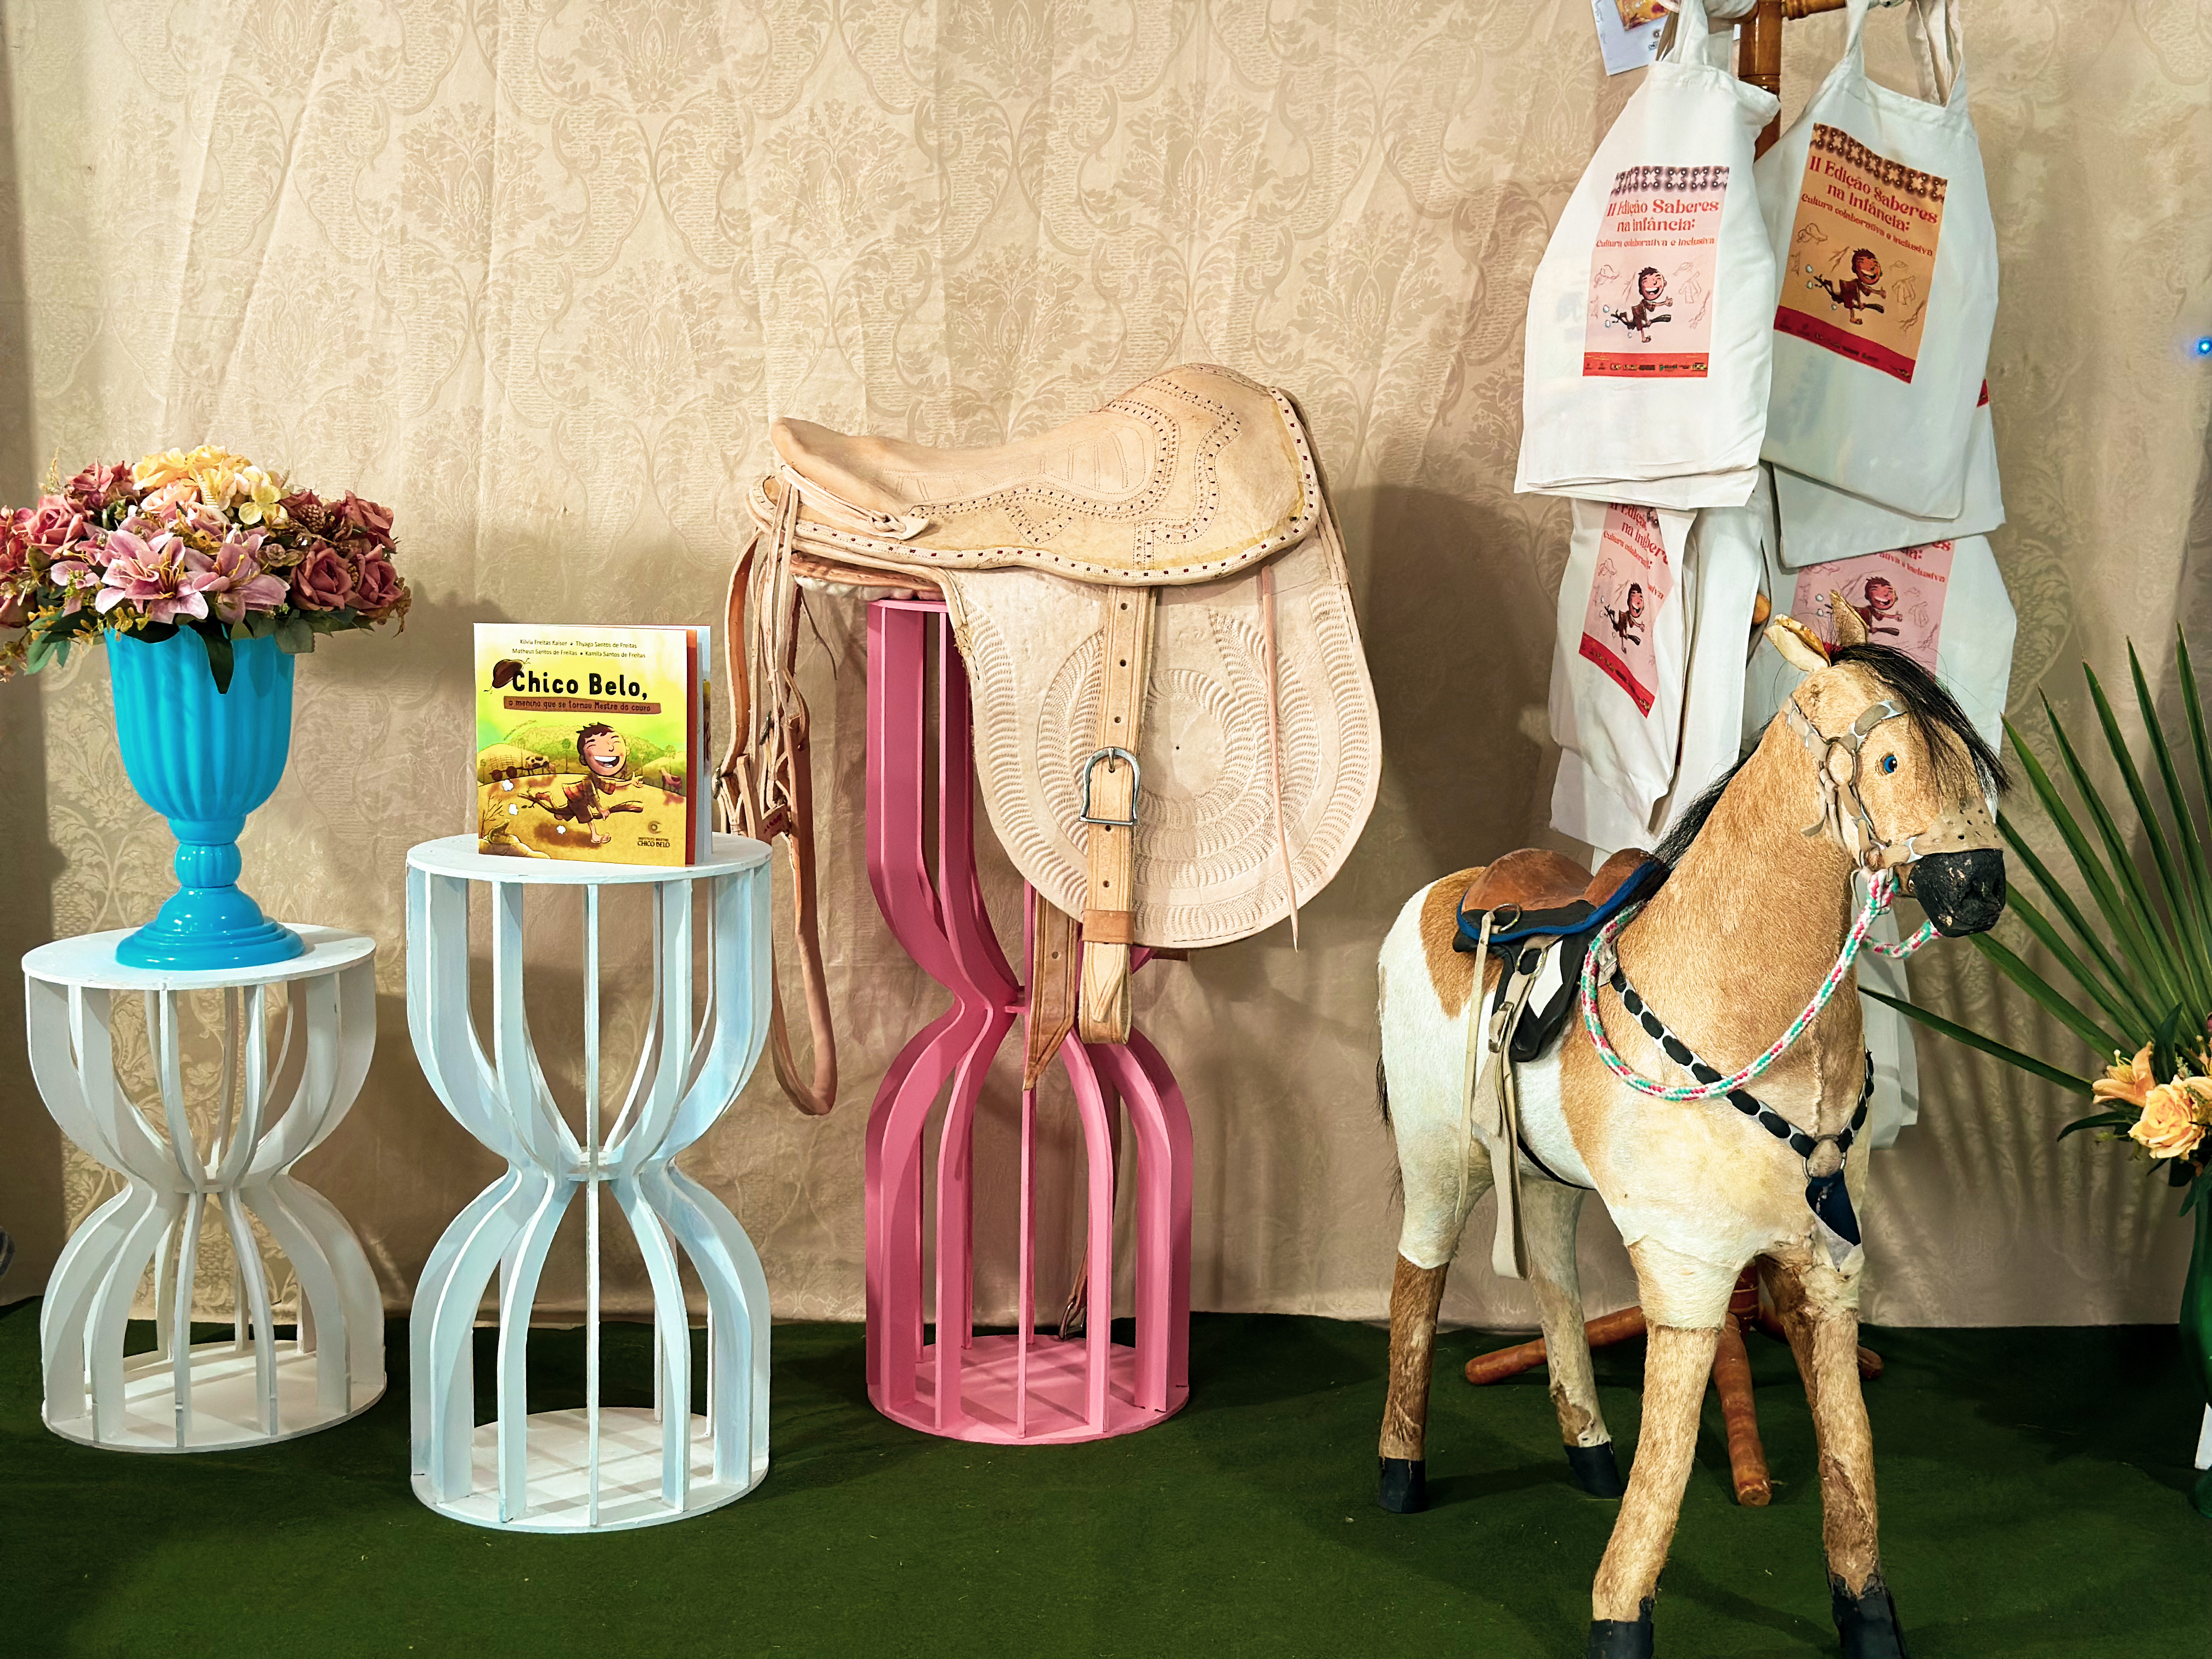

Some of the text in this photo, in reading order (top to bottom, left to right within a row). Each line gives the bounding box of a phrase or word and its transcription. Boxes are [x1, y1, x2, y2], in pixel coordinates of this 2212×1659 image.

[1810, 156, 1938, 224] II Edição Saberes
[1827, 184, 1844, 201] na
[1607, 199, 1719, 217] II Edição Saberes
[1802, 193, 1833, 212] Cultura
[1835, 207, 1884, 236] colaborativa
[1886, 232, 1892, 240] e
[1617, 221, 1630, 232] na
[1596, 239, 1622, 247] Cultura
[1624, 238, 1667, 247] colaborativa
[1622, 522, 1634, 538] na
[512, 670, 647, 701] Chico Belo,
[568, 700, 592, 709] tornou
[595, 701, 618, 710] Mestre
